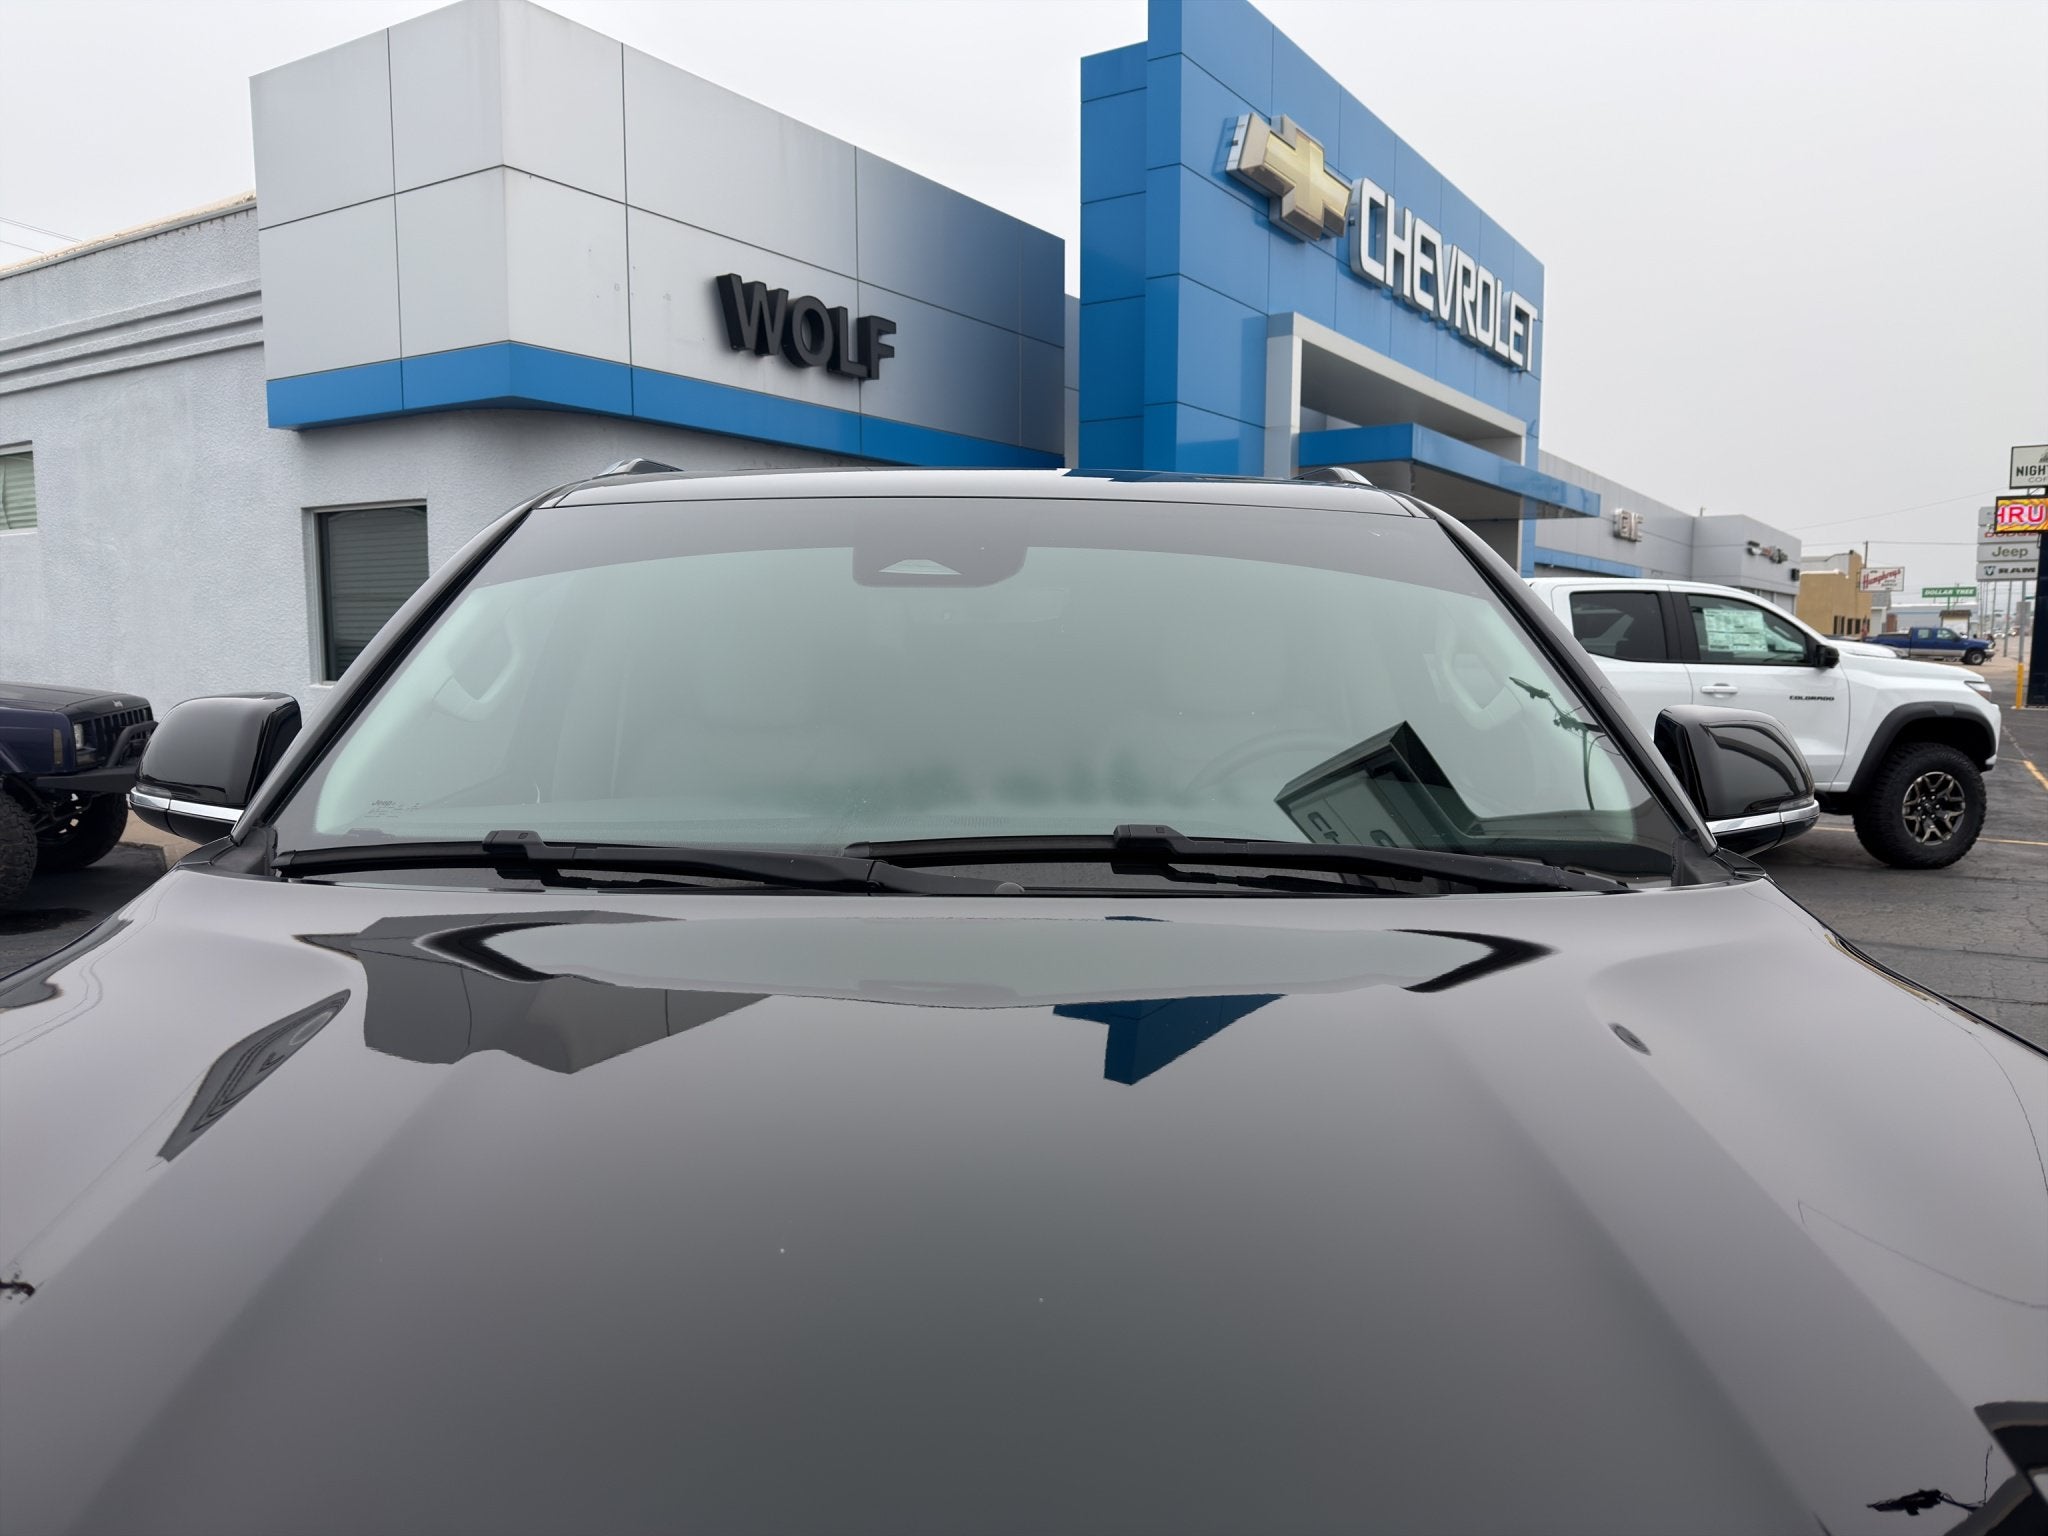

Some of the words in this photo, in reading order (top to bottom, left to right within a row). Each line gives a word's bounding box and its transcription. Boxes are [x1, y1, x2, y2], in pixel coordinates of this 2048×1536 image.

[1352, 177, 1538, 371] CHEVROLET
[717, 273, 896, 380] WOLF
[2016, 465, 2048, 477] NIGH
[1992, 546, 2028, 558] Jeep
